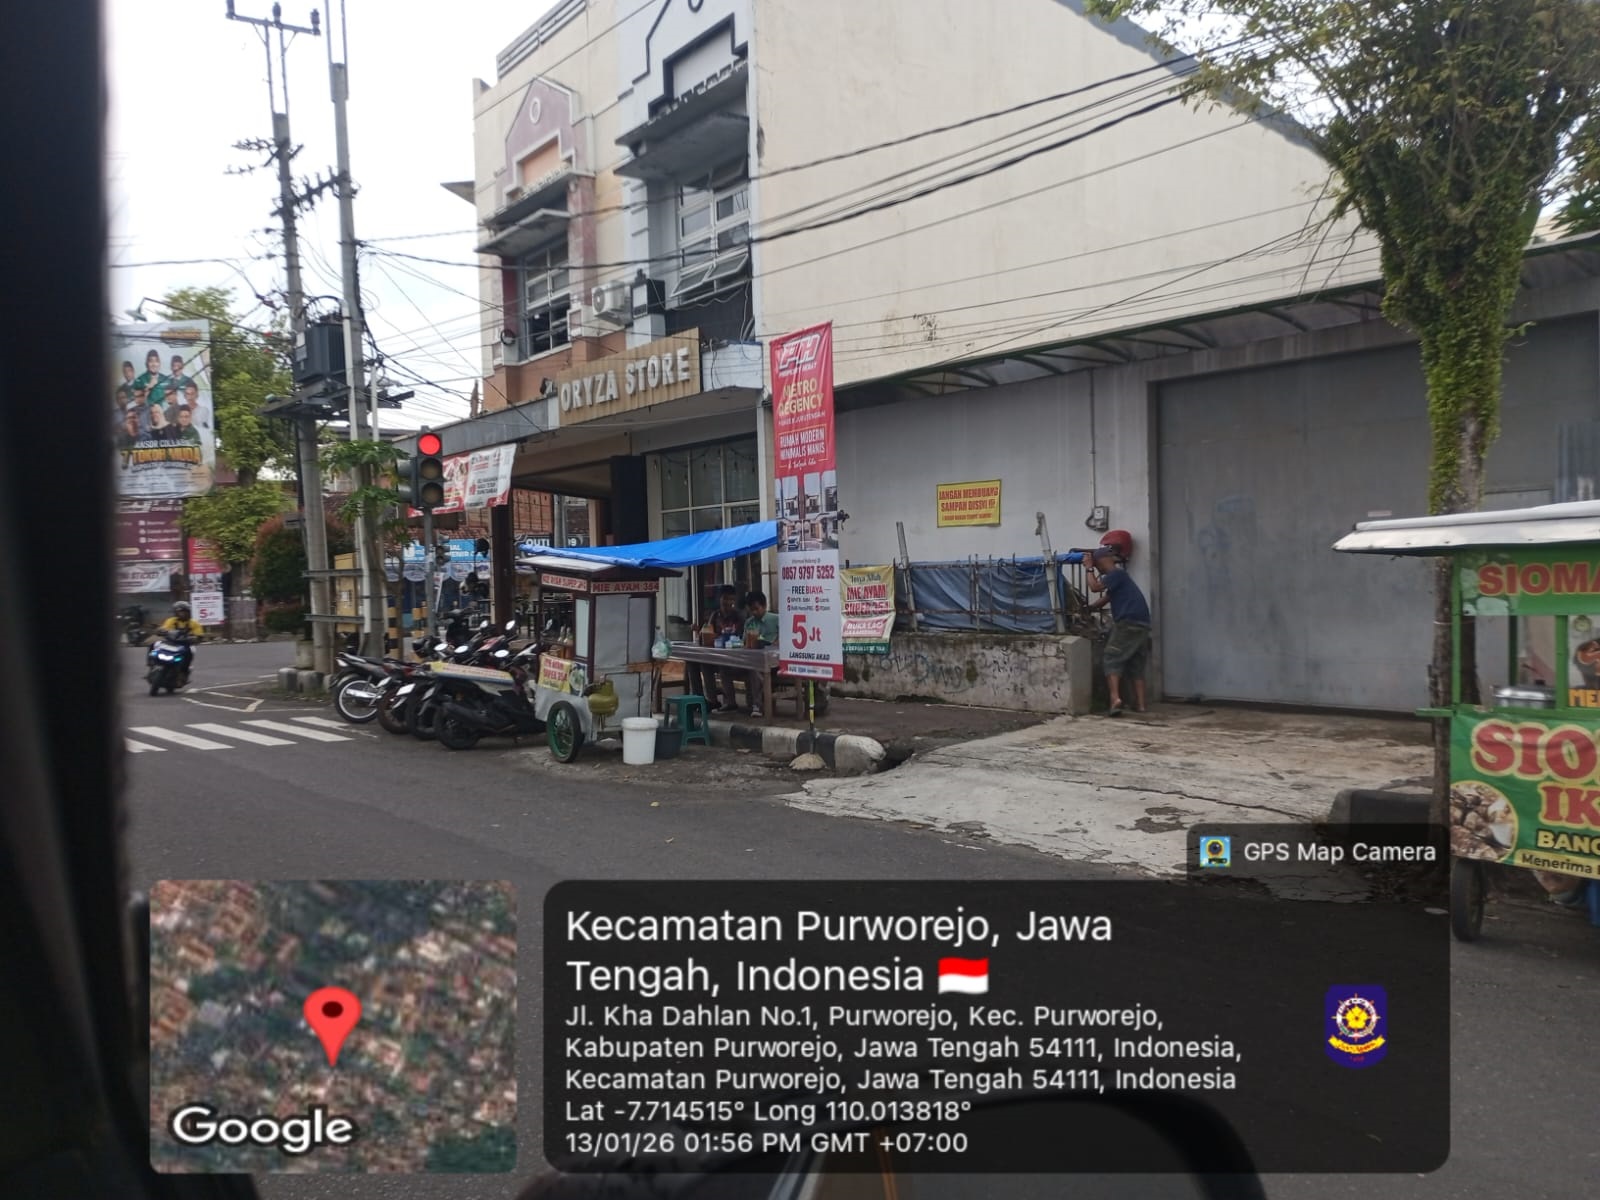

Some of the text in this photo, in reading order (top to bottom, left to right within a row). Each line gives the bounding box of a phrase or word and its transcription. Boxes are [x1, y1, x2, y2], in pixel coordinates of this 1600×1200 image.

[561, 347, 690, 412] ORYZA STORE
[783, 378, 817, 400] METRO
[778, 394, 824, 417] REGENCY
[780, 428, 825, 447] RUMAH MODERN
[780, 442, 825, 460] MINIMALIS MANIS
[939, 490, 962, 500] JANGAN
[941, 501, 967, 512] SAMPAH
[781, 564, 835, 580] 0857 9797 5252
[592, 583, 610, 592] MIE
[614, 582, 640, 592] AYAM
[791, 585, 824, 595] FREE BIAYA
[863, 584, 887, 599] AYAM
[791, 614, 822, 650] 5 Jt
[789, 651, 831, 661] LANGSUNG AKAD
[1471, 720, 1600, 783] SIO
[1522, 853, 1593, 874] Menerima
